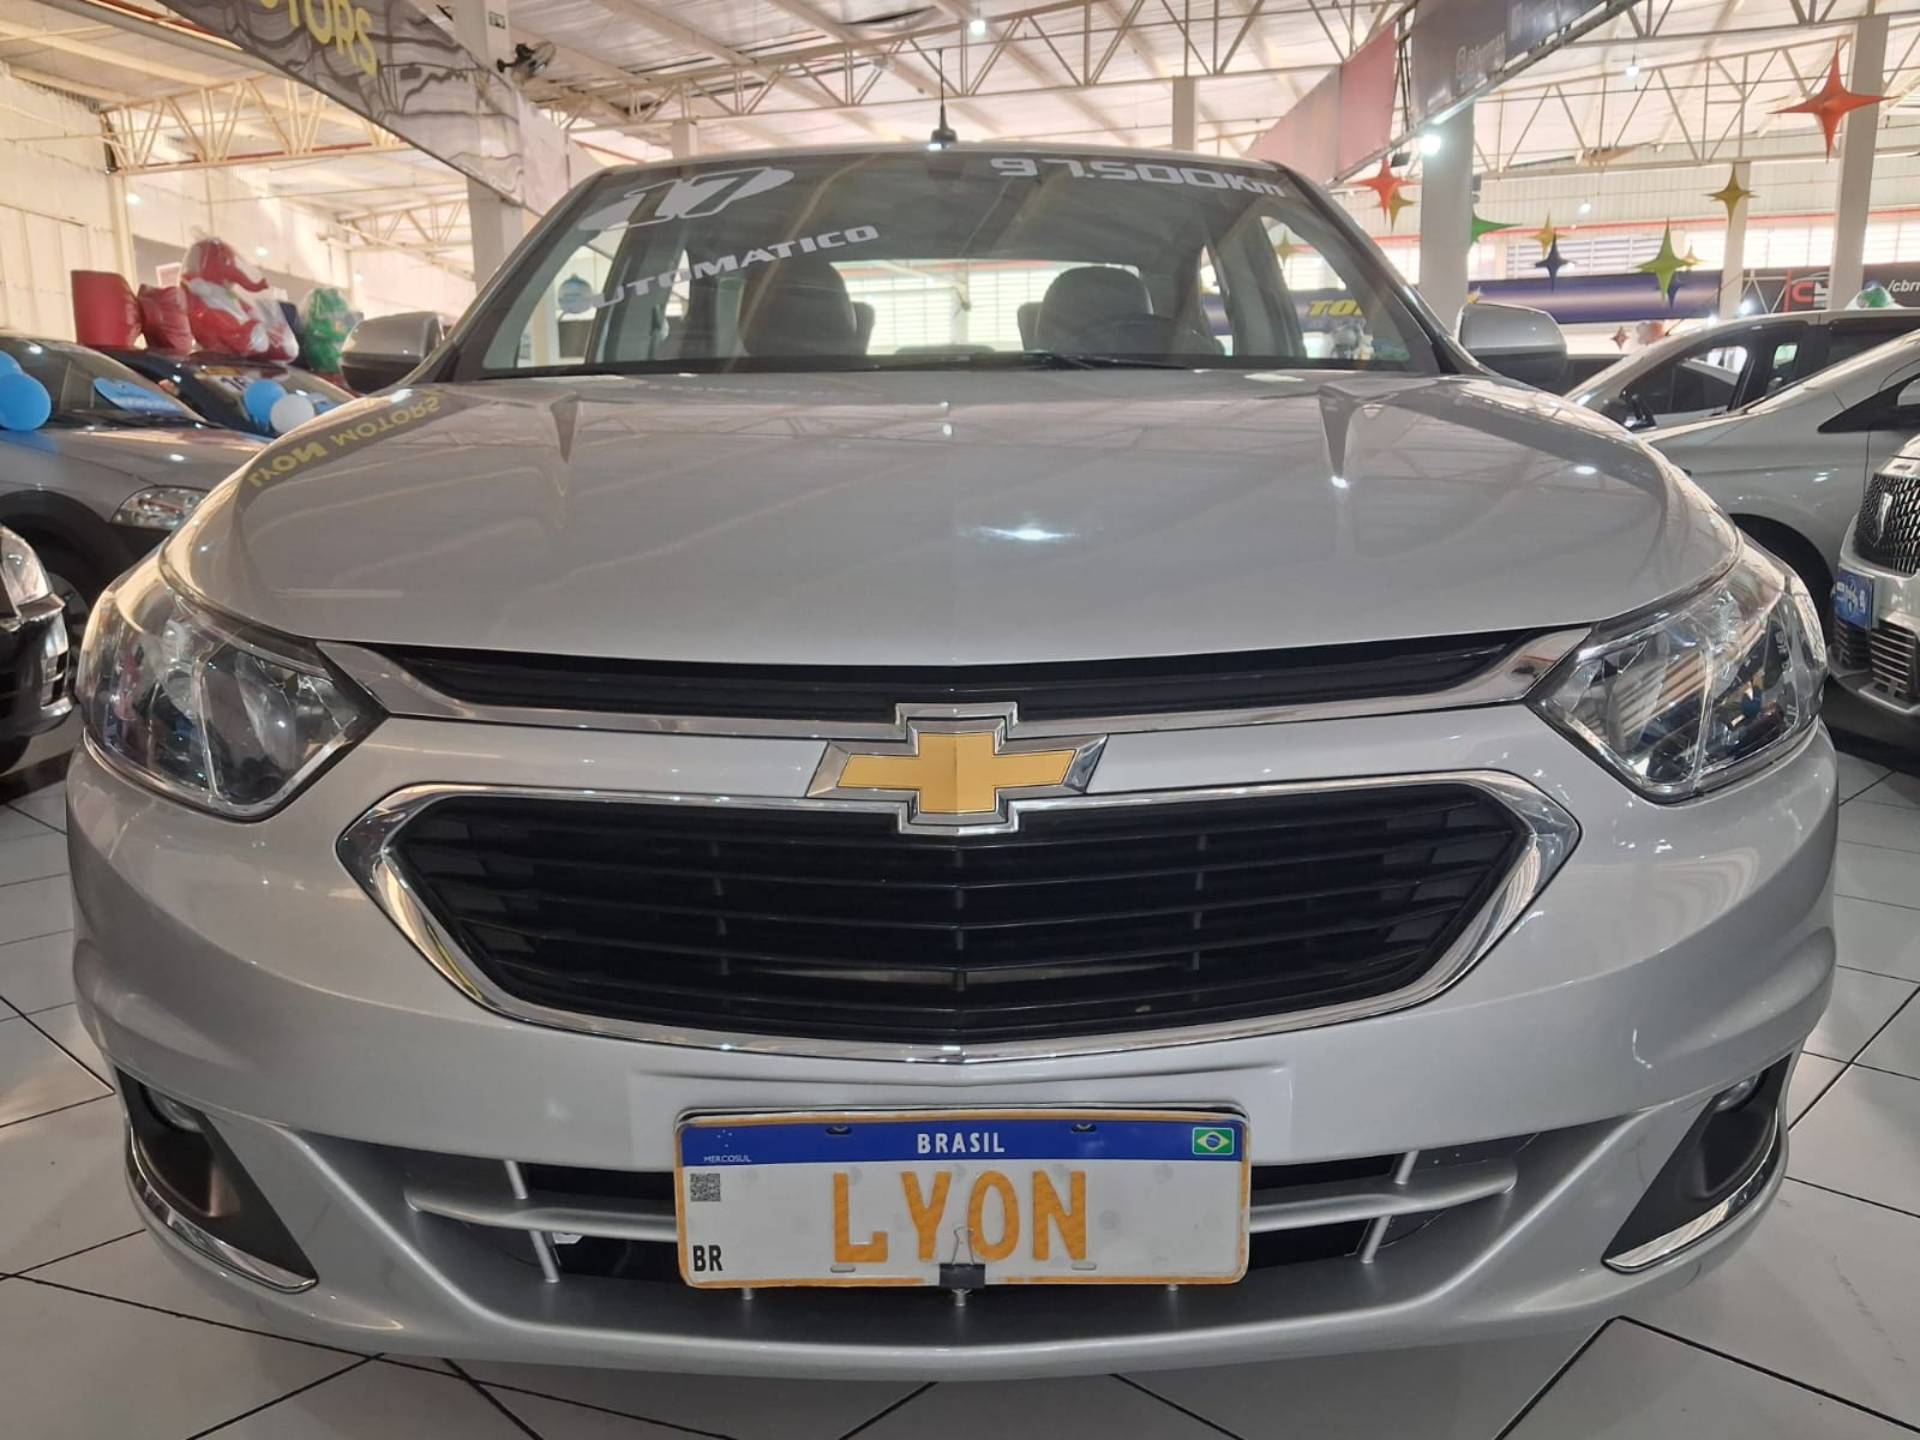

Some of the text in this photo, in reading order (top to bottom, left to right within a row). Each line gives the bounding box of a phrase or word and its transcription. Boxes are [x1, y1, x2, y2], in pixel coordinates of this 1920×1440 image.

[606, 166, 774, 229] 17
[917, 1132, 1005, 1154] BRASIL
[703, 1154, 752, 1163] MERCOSUL
[833, 1169, 1087, 1263] LYON
[692, 1244, 723, 1272] BR
